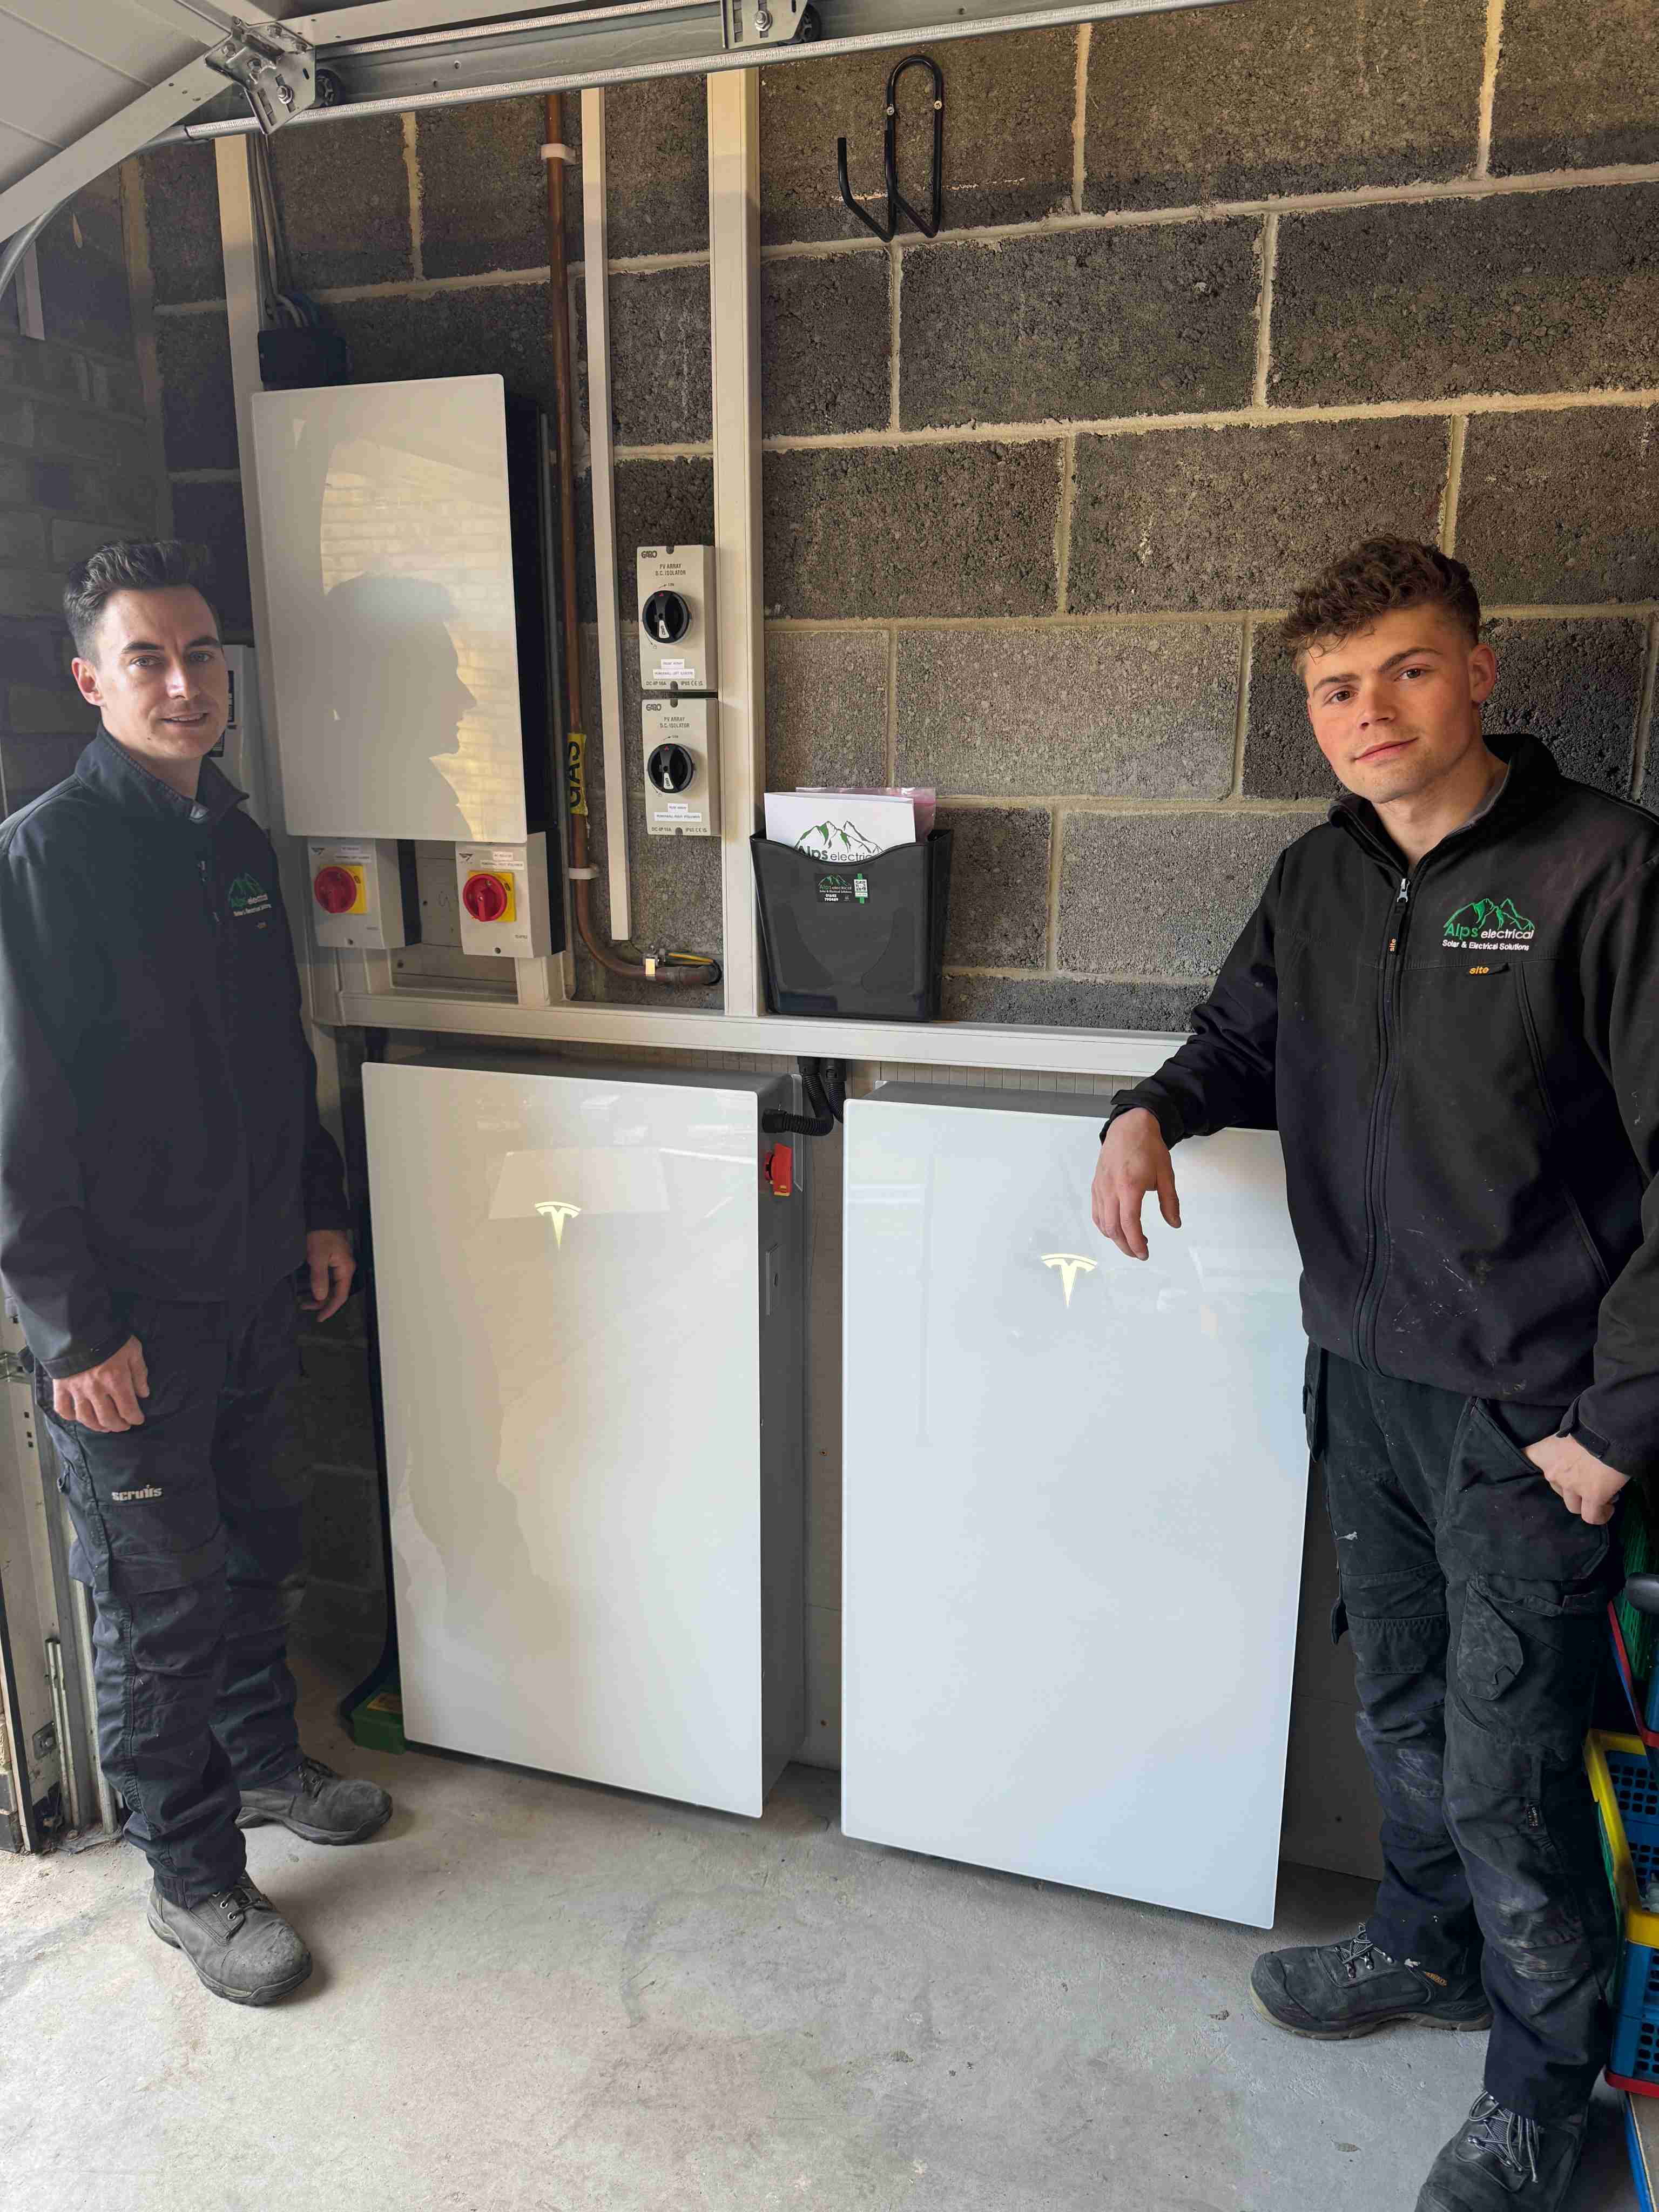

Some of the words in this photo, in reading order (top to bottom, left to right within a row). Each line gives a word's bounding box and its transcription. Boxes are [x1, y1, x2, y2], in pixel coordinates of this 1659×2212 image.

[1444, 923, 1478, 940] Alps
[1481, 929, 1534, 939] electrical
[1442, 940, 1459, 948] Solar
[1468, 942, 1498, 950] Electrical
[1499, 943, 1529, 951] Solutions
[1469, 965, 1490, 975] site
